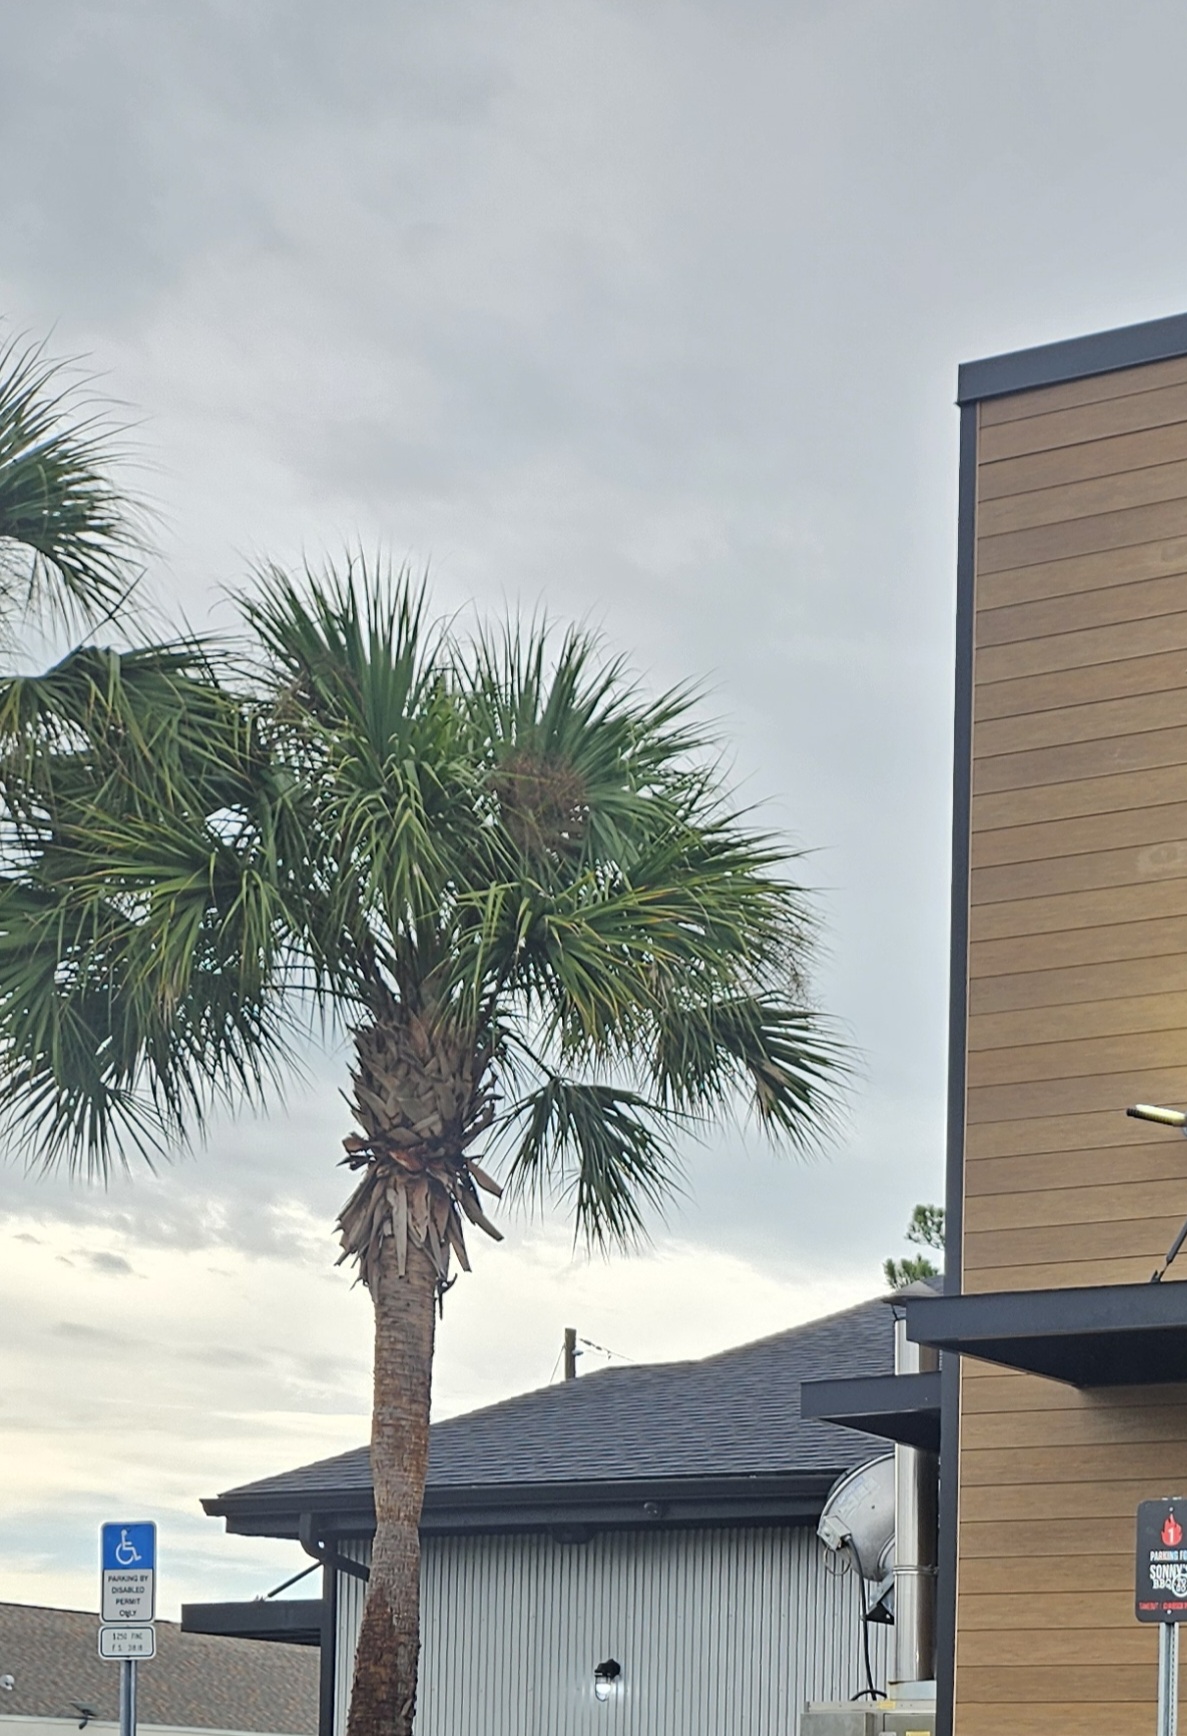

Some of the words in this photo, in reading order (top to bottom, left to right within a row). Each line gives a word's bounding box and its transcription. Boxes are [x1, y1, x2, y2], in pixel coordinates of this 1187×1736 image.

[1168, 1527, 1174, 1543] 1
[1150, 1551, 1179, 1561] PARKING
[108, 1575, 138, 1583] PARKING
[1152, 1579, 1174, 1591] BBQ
[111, 1586, 145, 1594] DISABLED
[115, 1598, 141, 1606] PERMIT
[119, 1609, 137, 1618] ONLY
